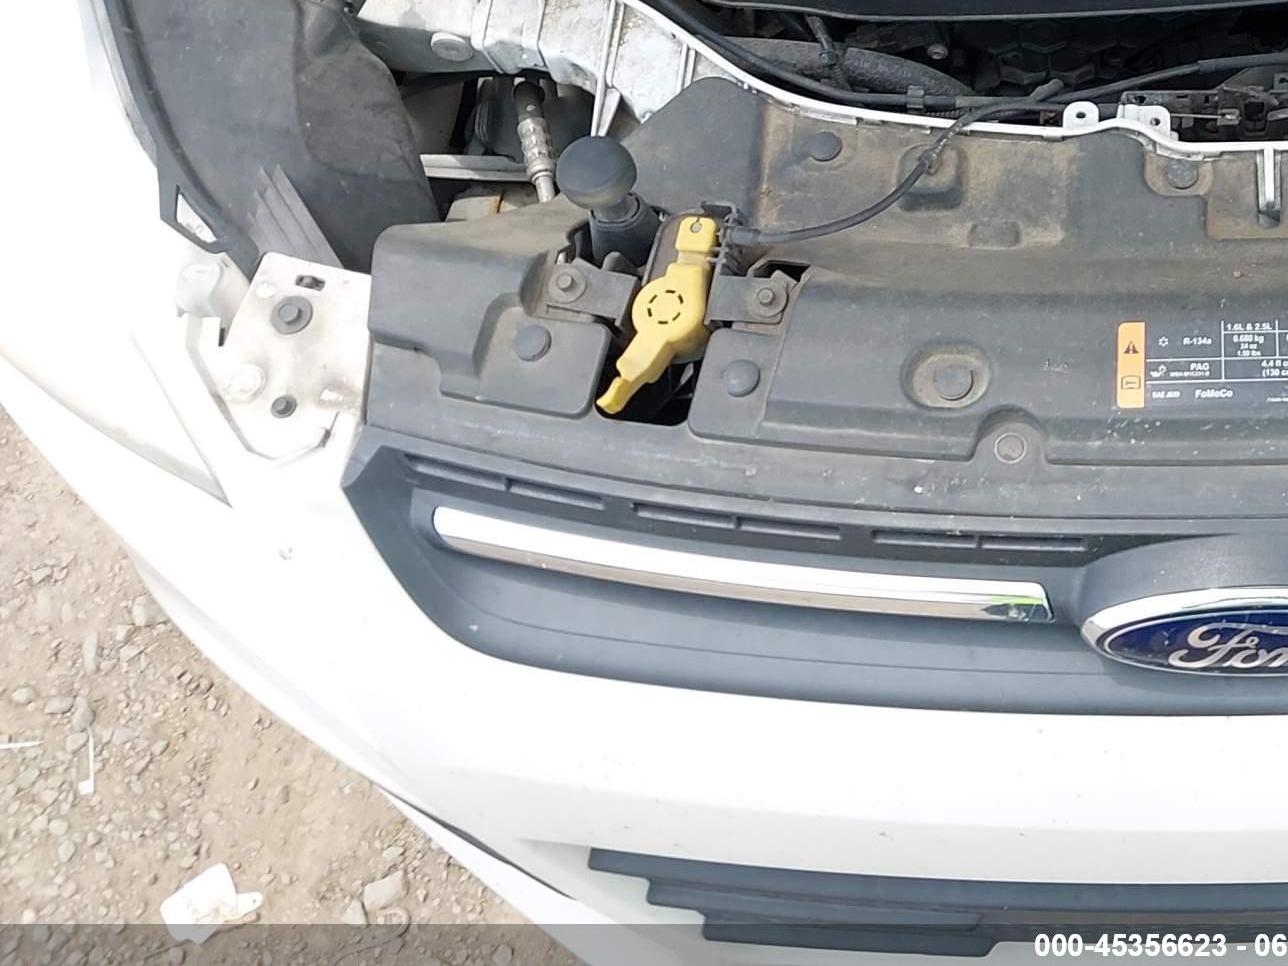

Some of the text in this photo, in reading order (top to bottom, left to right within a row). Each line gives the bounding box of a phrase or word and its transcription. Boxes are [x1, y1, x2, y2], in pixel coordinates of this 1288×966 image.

[1182, 336, 1213, 346] R-134a
[1254, 334, 1265, 344] kg
[1190, 362, 1210, 371] PAG
[1261, 359, 1274, 368] 4.4
[1194, 388, 1234, 399] FoMoCo
